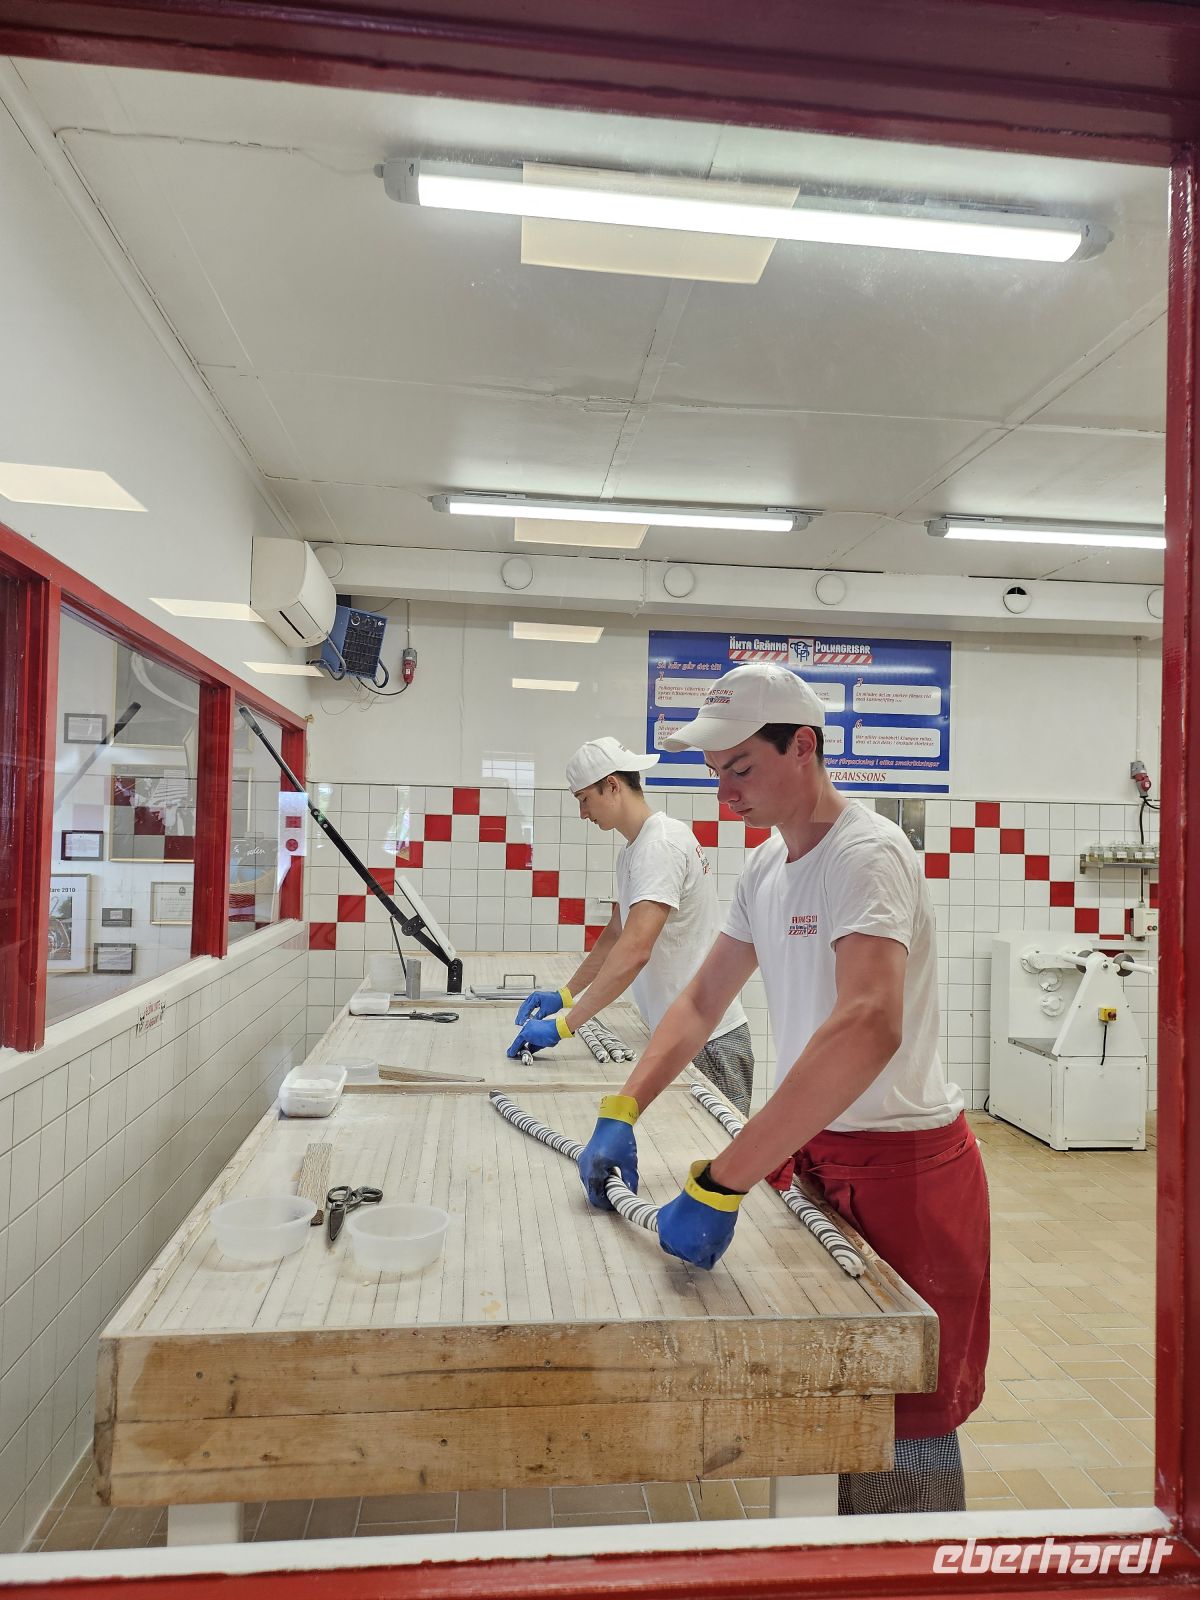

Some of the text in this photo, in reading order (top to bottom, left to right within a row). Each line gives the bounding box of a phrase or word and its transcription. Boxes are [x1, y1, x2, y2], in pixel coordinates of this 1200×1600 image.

[815, 641, 871, 654] POLKAGRISAR
[668, 661, 681, 669] här
[682, 661, 697, 671] går
[697, 662, 710, 671] det
[710, 663, 722, 671] till
[856, 676, 864, 687] 3
[855, 719, 863, 729] 6
[838, 758, 875, 767] förpackning
[830, 771, 887, 782] FRANSSONS
